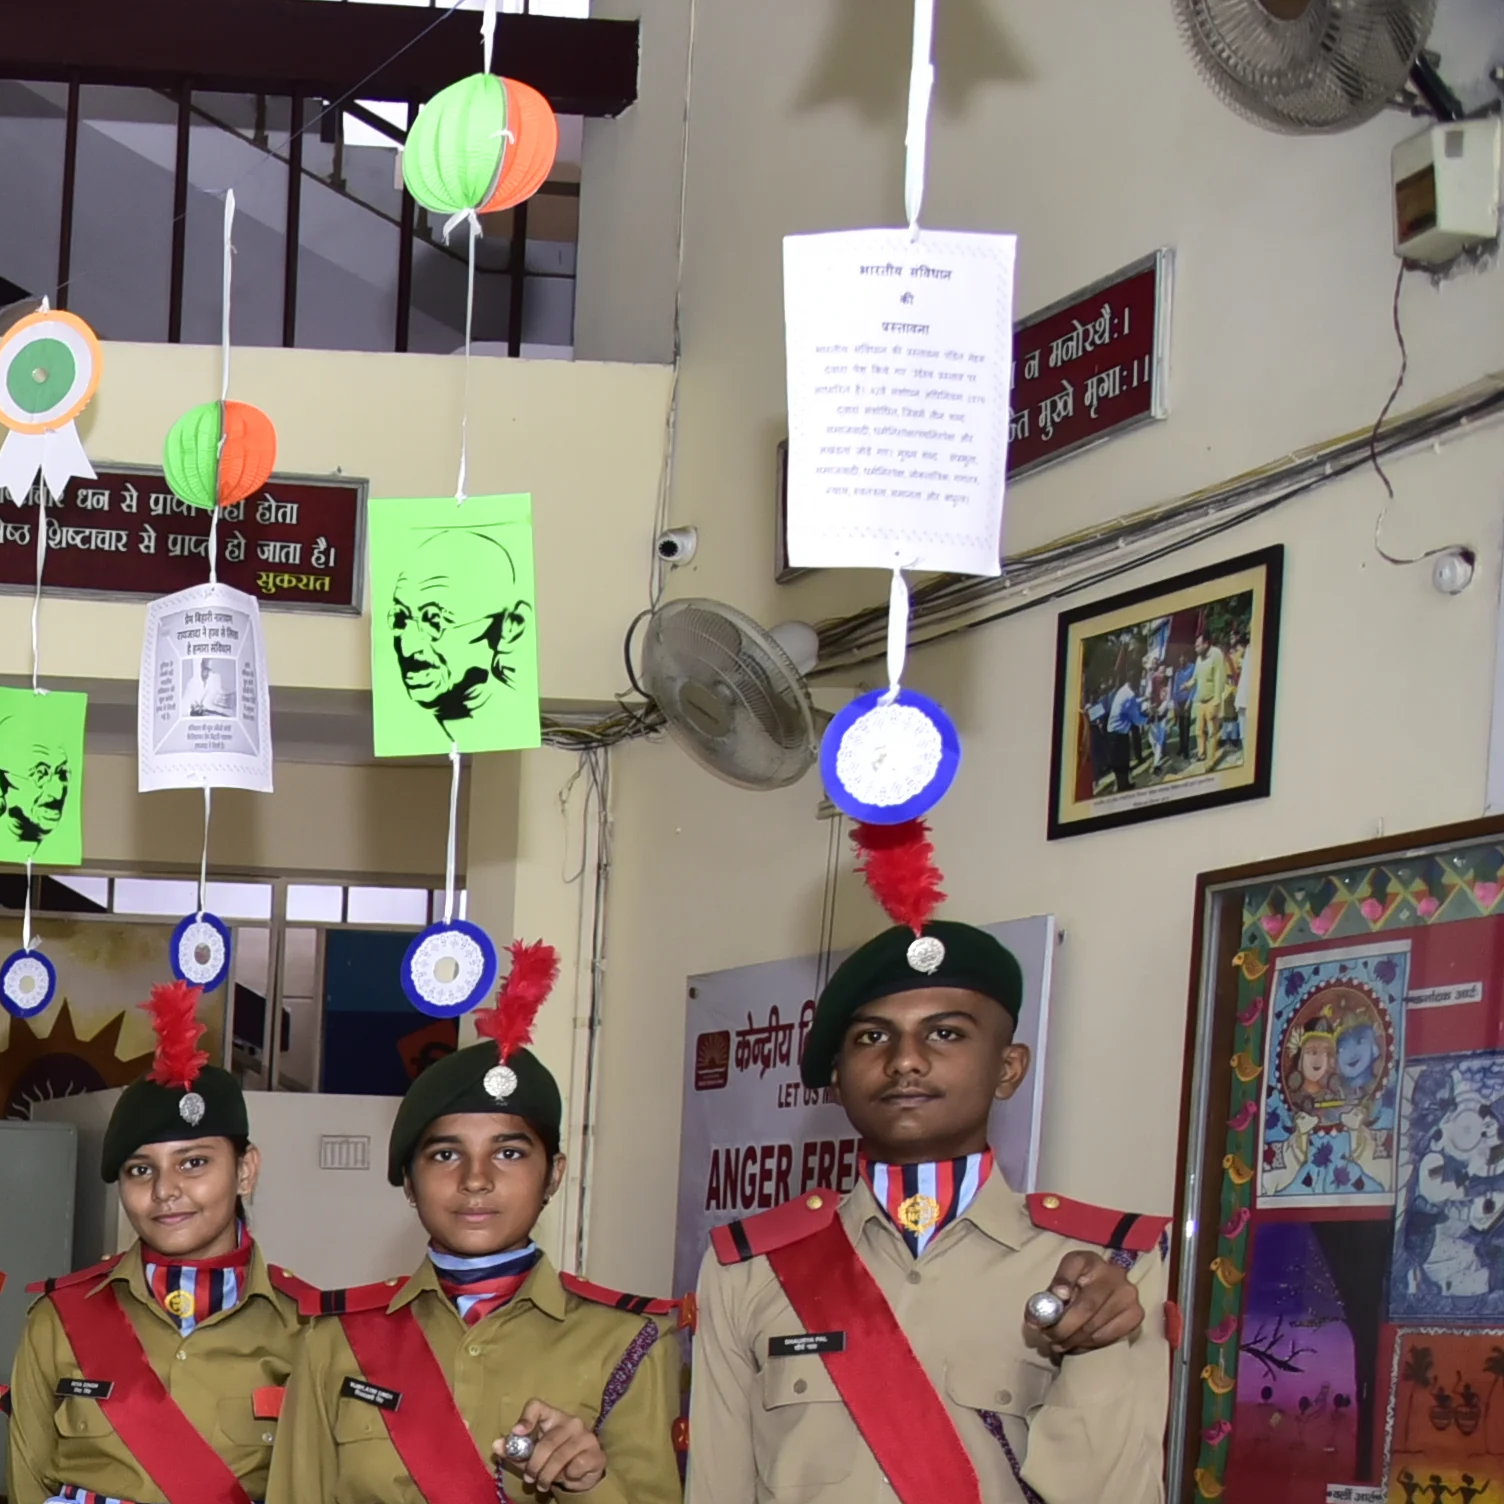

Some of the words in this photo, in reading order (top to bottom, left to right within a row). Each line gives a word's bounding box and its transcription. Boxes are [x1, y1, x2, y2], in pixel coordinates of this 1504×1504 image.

[859, 262, 903, 277] भारतीय
[910, 264, 953, 281] संविधान
[900, 291, 914, 306] की
[1024, 348, 1041, 381] न
[75, 487, 111, 511] धन
[120, 482, 139, 514] से
[255, 492, 299, 525] होता
[44, 517, 129, 553] शिष्टाचार
[138, 522, 156, 554] से
[224, 530, 246, 562] हो
[257, 540, 302, 566] जाता
[311, 536, 336, 569] है।
[255, 571, 331, 595] सुकरात
[734, 1004, 795, 1080] केन्द्रीय
[777, 1082, 800, 1109] LET
[803, 1084, 821, 1106] US
[705, 1143, 793, 1211] ANGER
